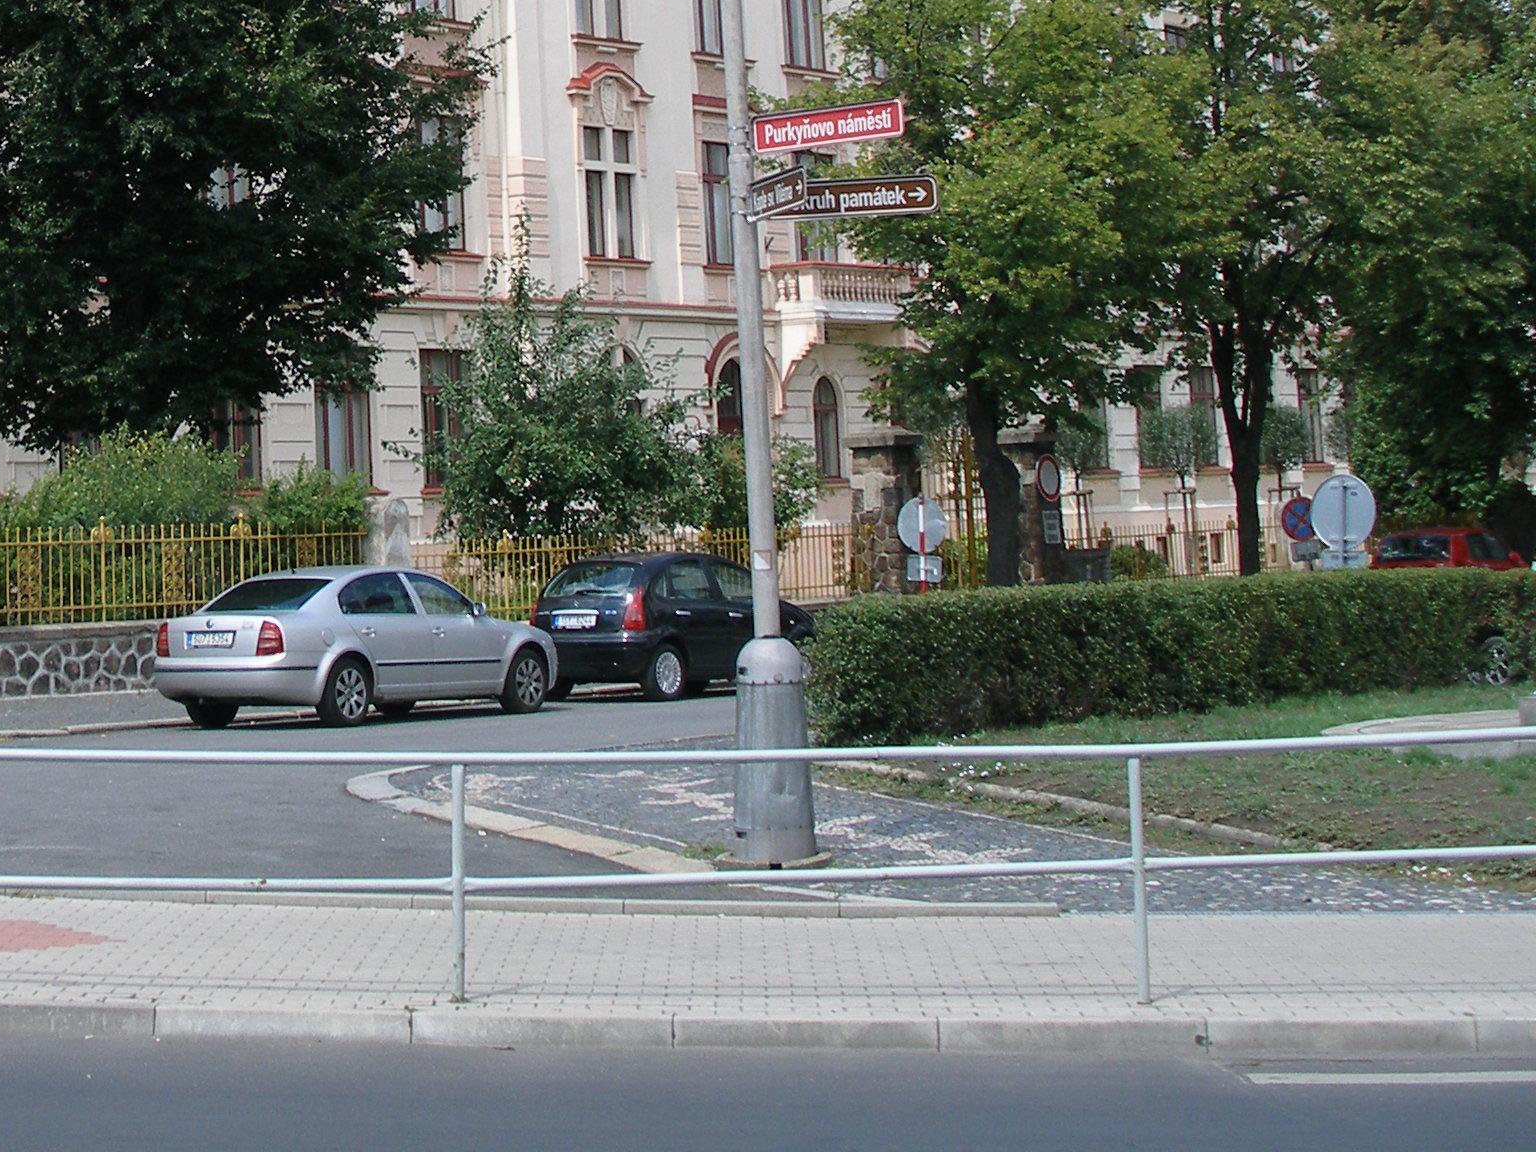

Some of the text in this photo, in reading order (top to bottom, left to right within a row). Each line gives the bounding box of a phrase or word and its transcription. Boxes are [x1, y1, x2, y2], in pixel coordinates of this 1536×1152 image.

[765, 108, 892, 144] Purkyňovo náměstí
[793, 185, 906, 214] kruh památek
